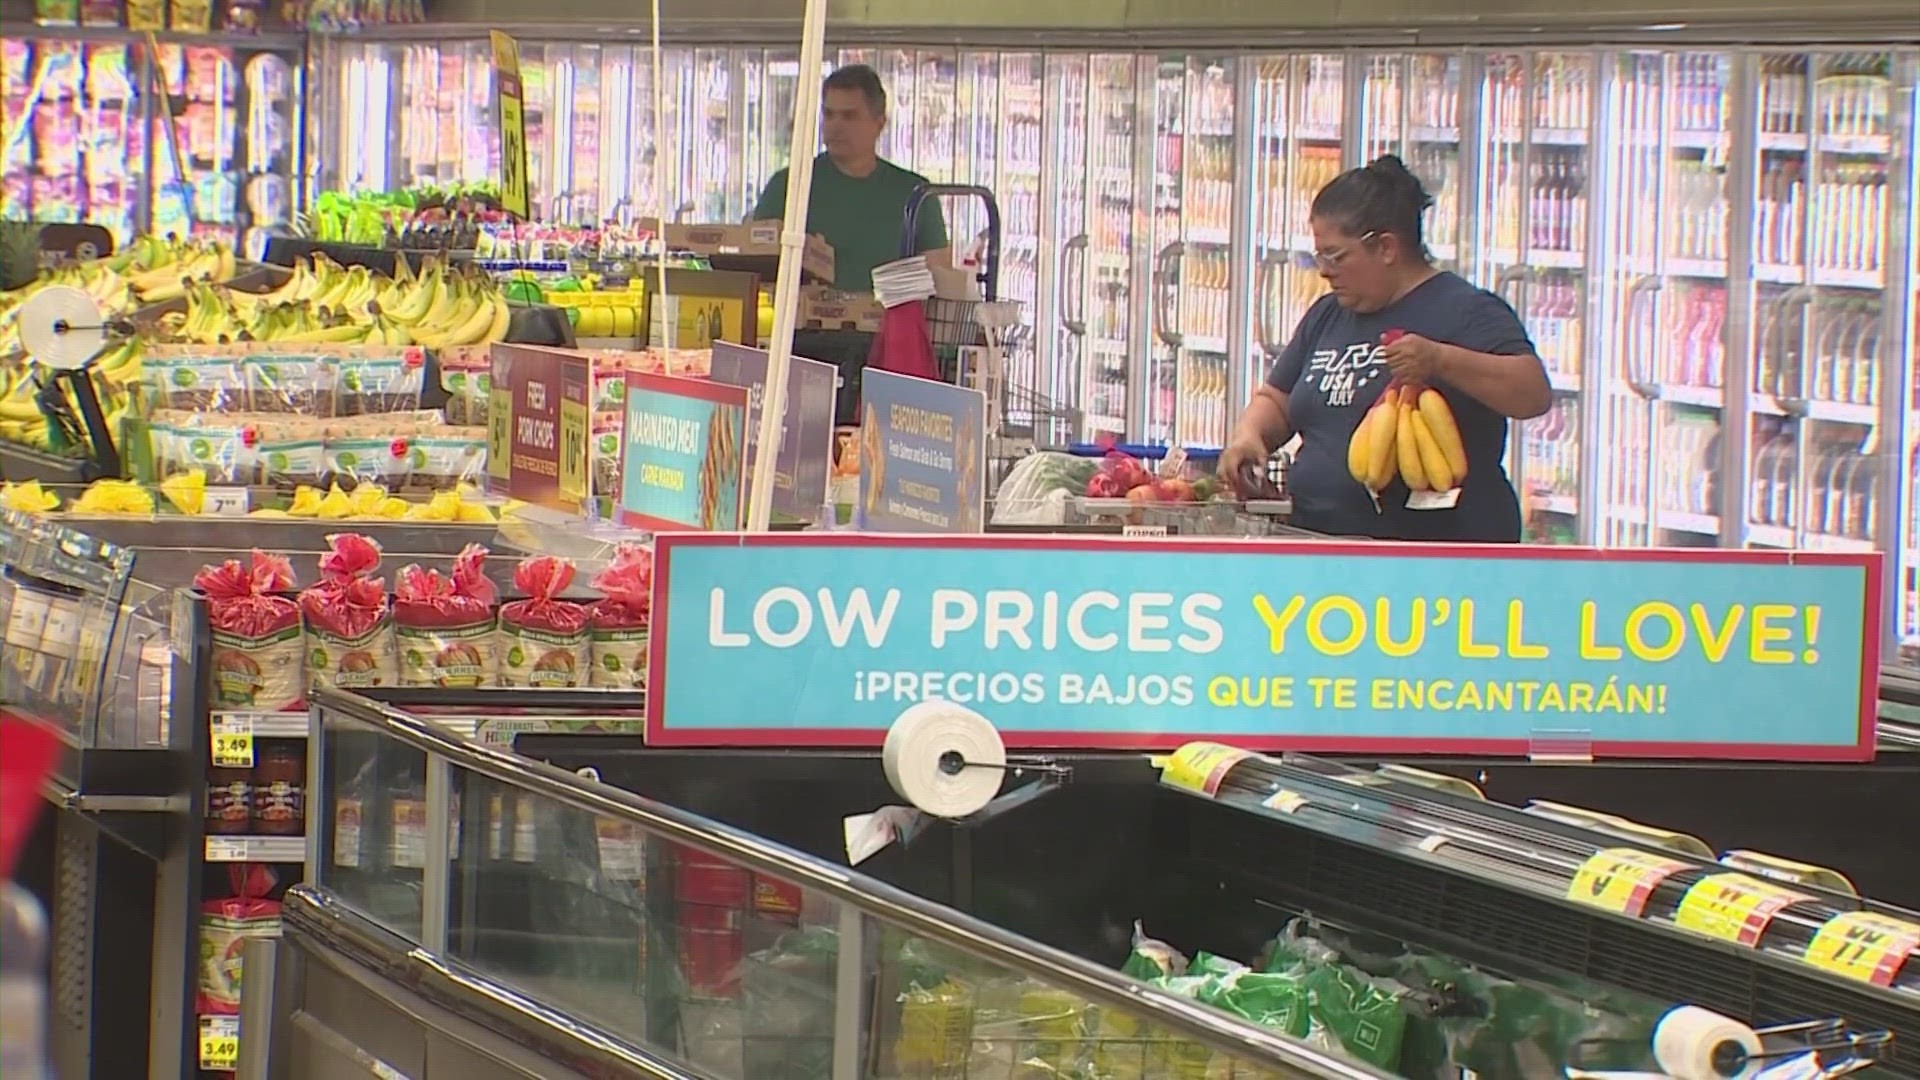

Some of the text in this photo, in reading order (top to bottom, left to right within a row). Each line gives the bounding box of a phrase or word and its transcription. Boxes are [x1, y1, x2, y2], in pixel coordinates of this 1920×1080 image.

[630, 410, 701, 456] MARINATED MEAT
[709, 586, 1822, 665] LOW PRICES YOU'LL LOVE!
[854, 671, 1667, 714] ¡PRECIOS BAJOS QUE TE ENCANTARÁN!
[217, 738, 247, 751] 3.49
[204, 1042, 235, 1055] 3.49
